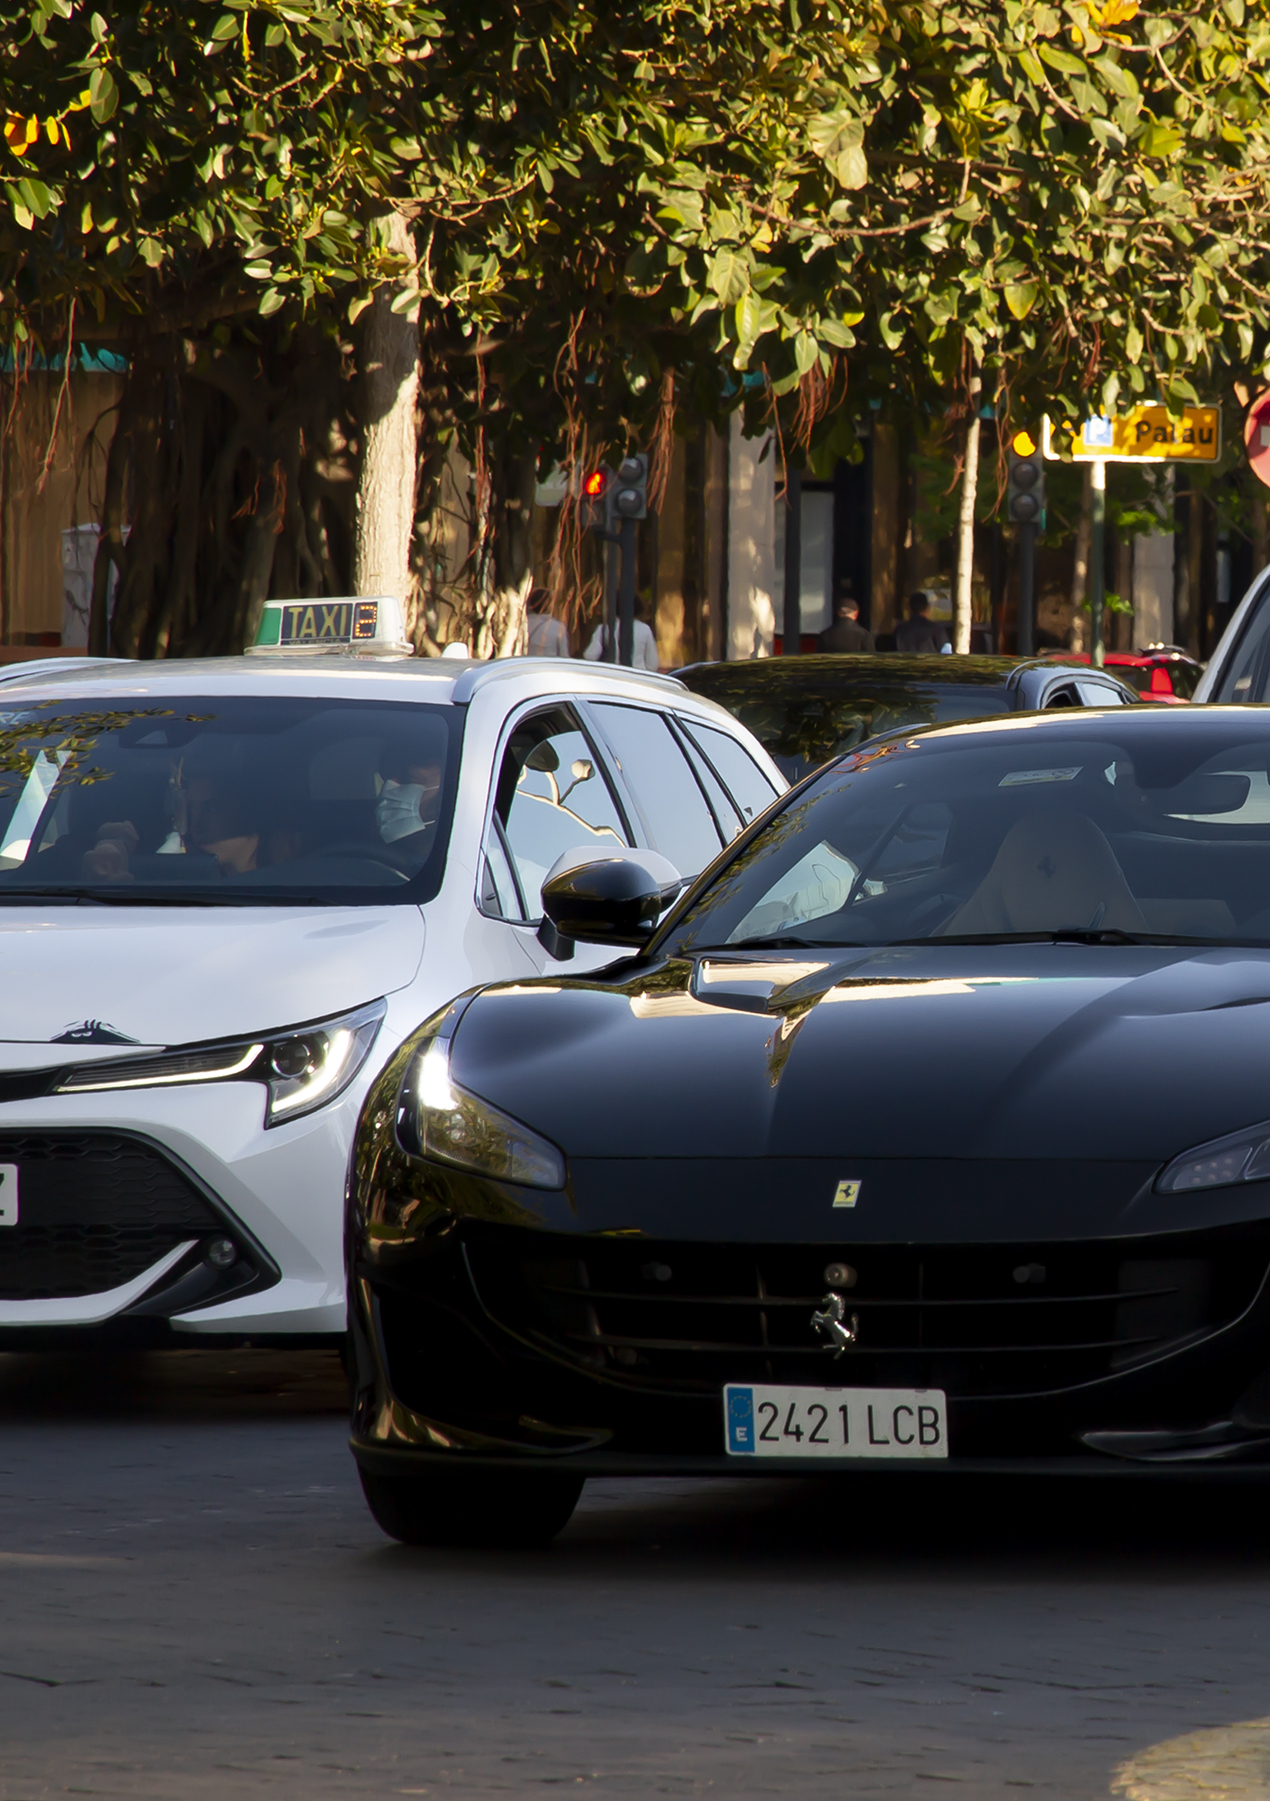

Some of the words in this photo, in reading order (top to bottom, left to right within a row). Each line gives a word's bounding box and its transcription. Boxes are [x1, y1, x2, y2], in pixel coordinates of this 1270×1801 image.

[1136, 421, 1213, 444] Palau
[288, 605, 347, 638] TAXI
[355, 605, 377, 637] 2
[735, 1427, 748, 1442] E
[758, 1401, 850, 1444] 2421
[867, 1404, 940, 1446] LCB
